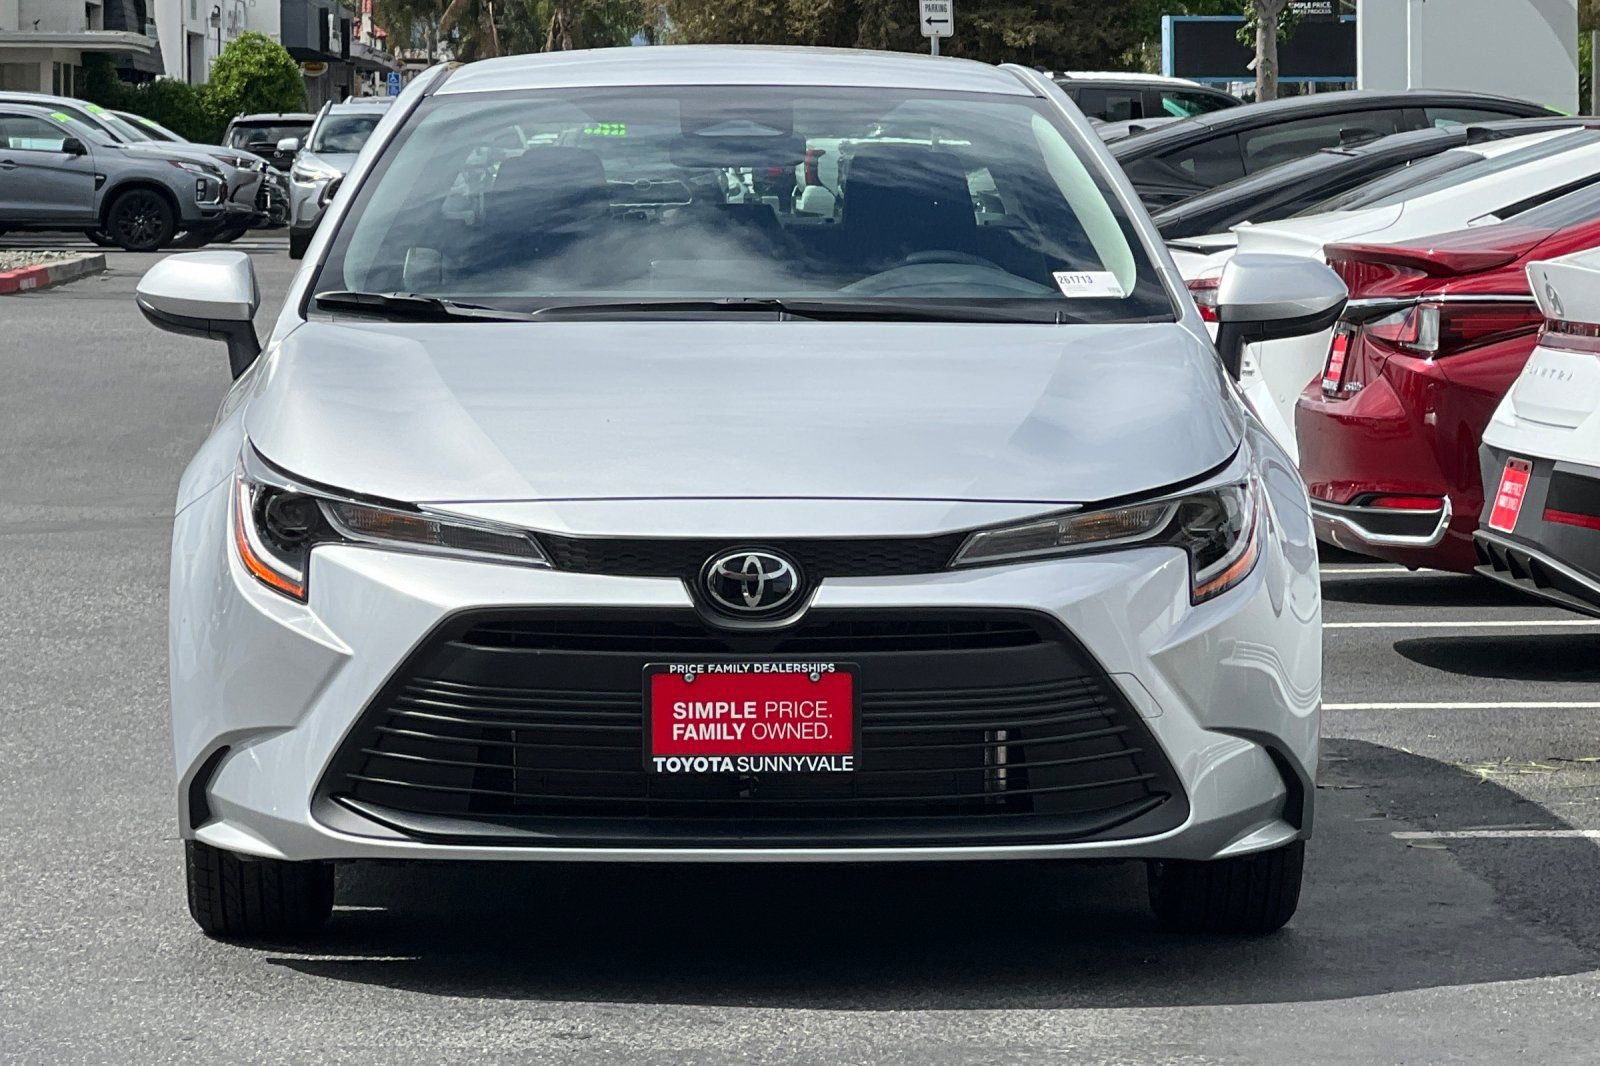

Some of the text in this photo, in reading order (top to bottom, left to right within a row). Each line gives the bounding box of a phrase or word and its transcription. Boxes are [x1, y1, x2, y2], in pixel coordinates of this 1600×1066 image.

[669, 663, 836, 674] PRICE FAMILY DEALERSHIPS
[672, 700, 833, 720] SIMPLE PRICE.
[672, 722, 833, 740] FAMILY OWNED.
[652, 756, 854, 773] TOYOTA SUNNYVALE
